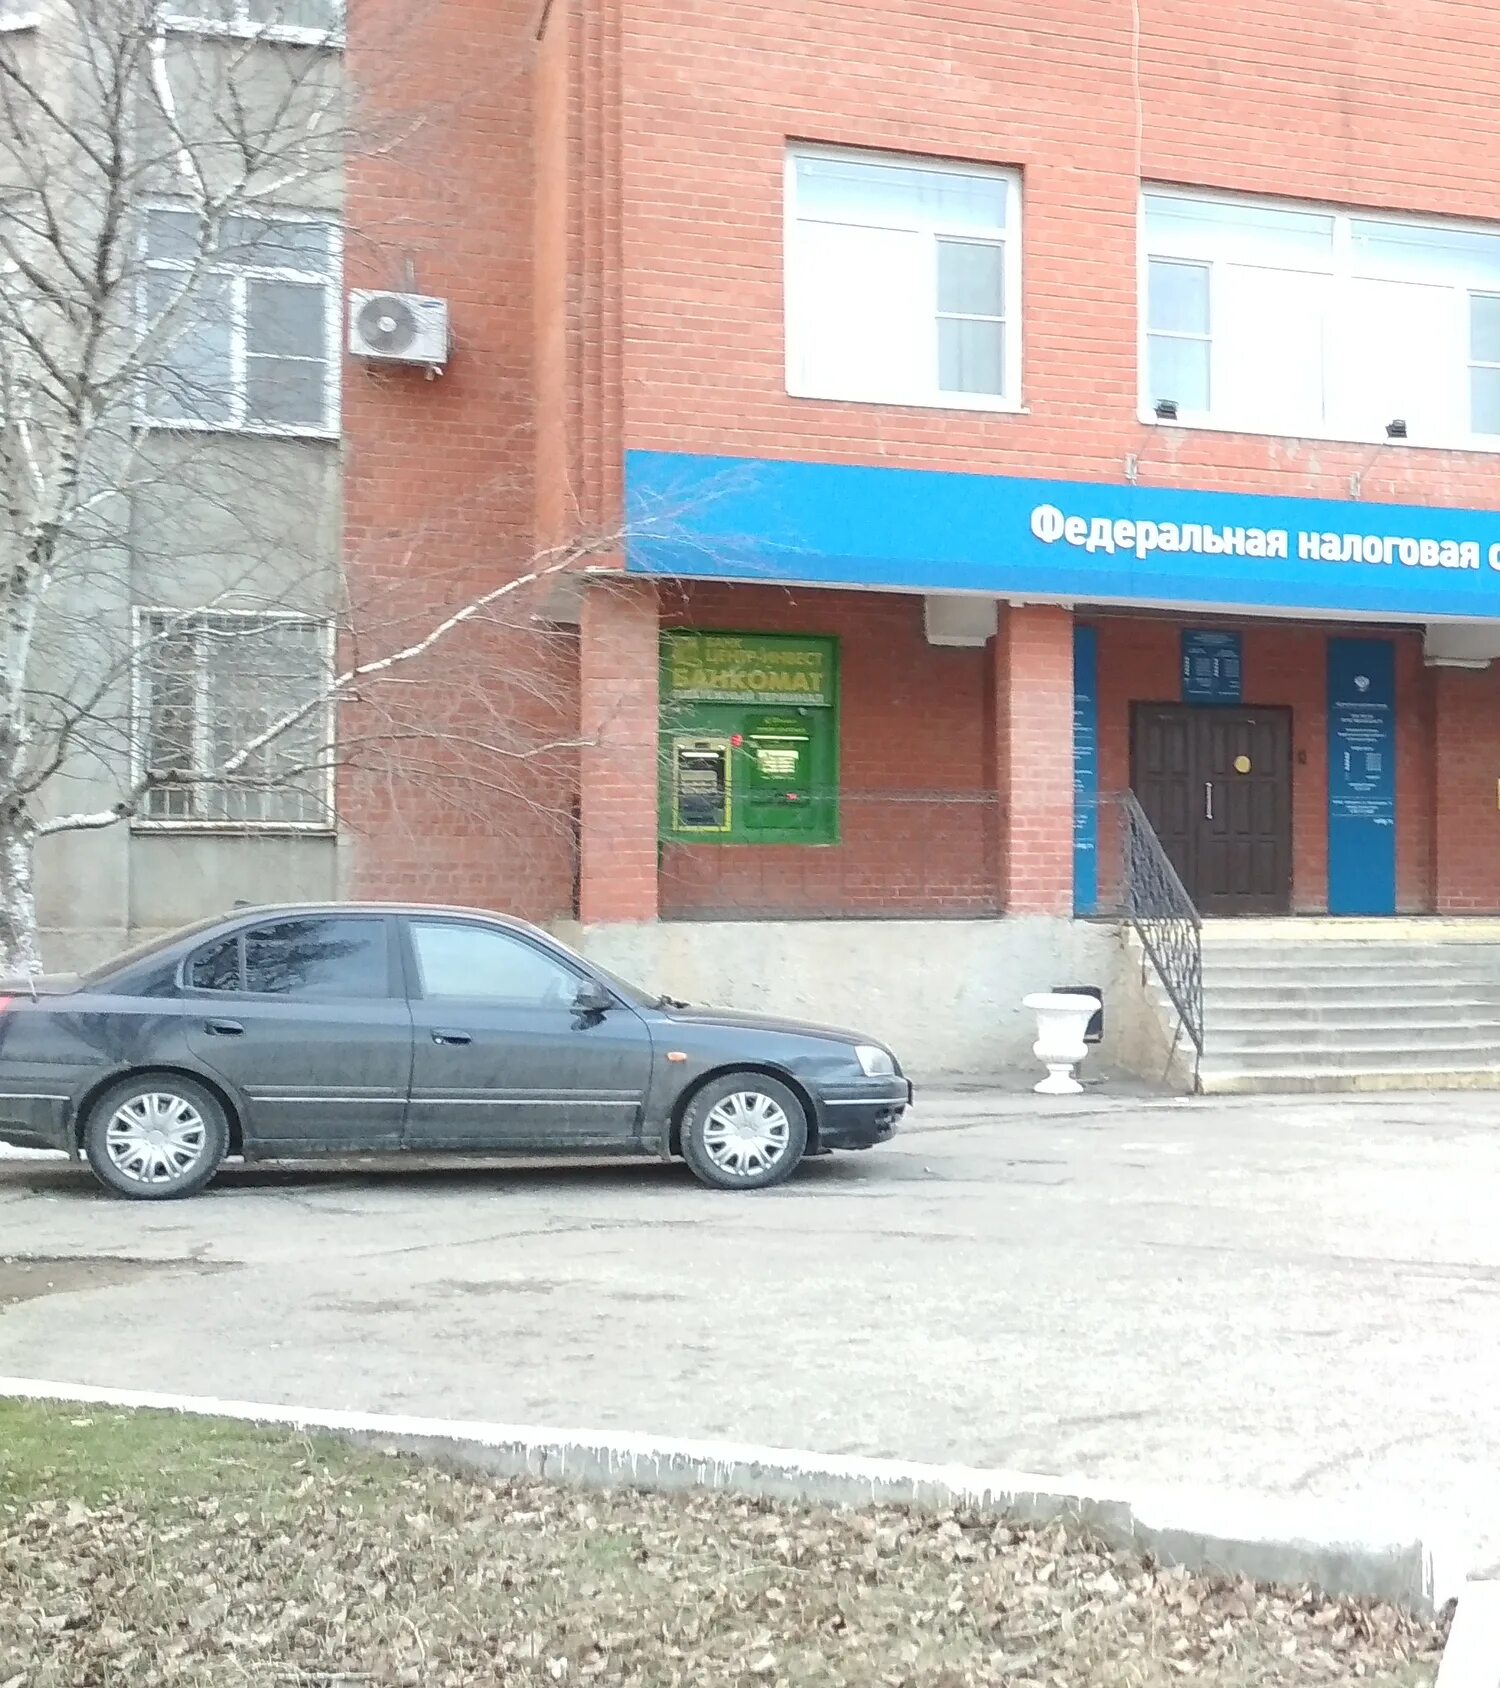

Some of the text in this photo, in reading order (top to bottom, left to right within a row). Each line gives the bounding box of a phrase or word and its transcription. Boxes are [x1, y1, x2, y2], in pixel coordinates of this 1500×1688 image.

[1030, 503, 1288, 560] Федеральная
[1298, 531, 1480, 569] налоговая
[672, 668, 823, 691] БАНКОМАТ
